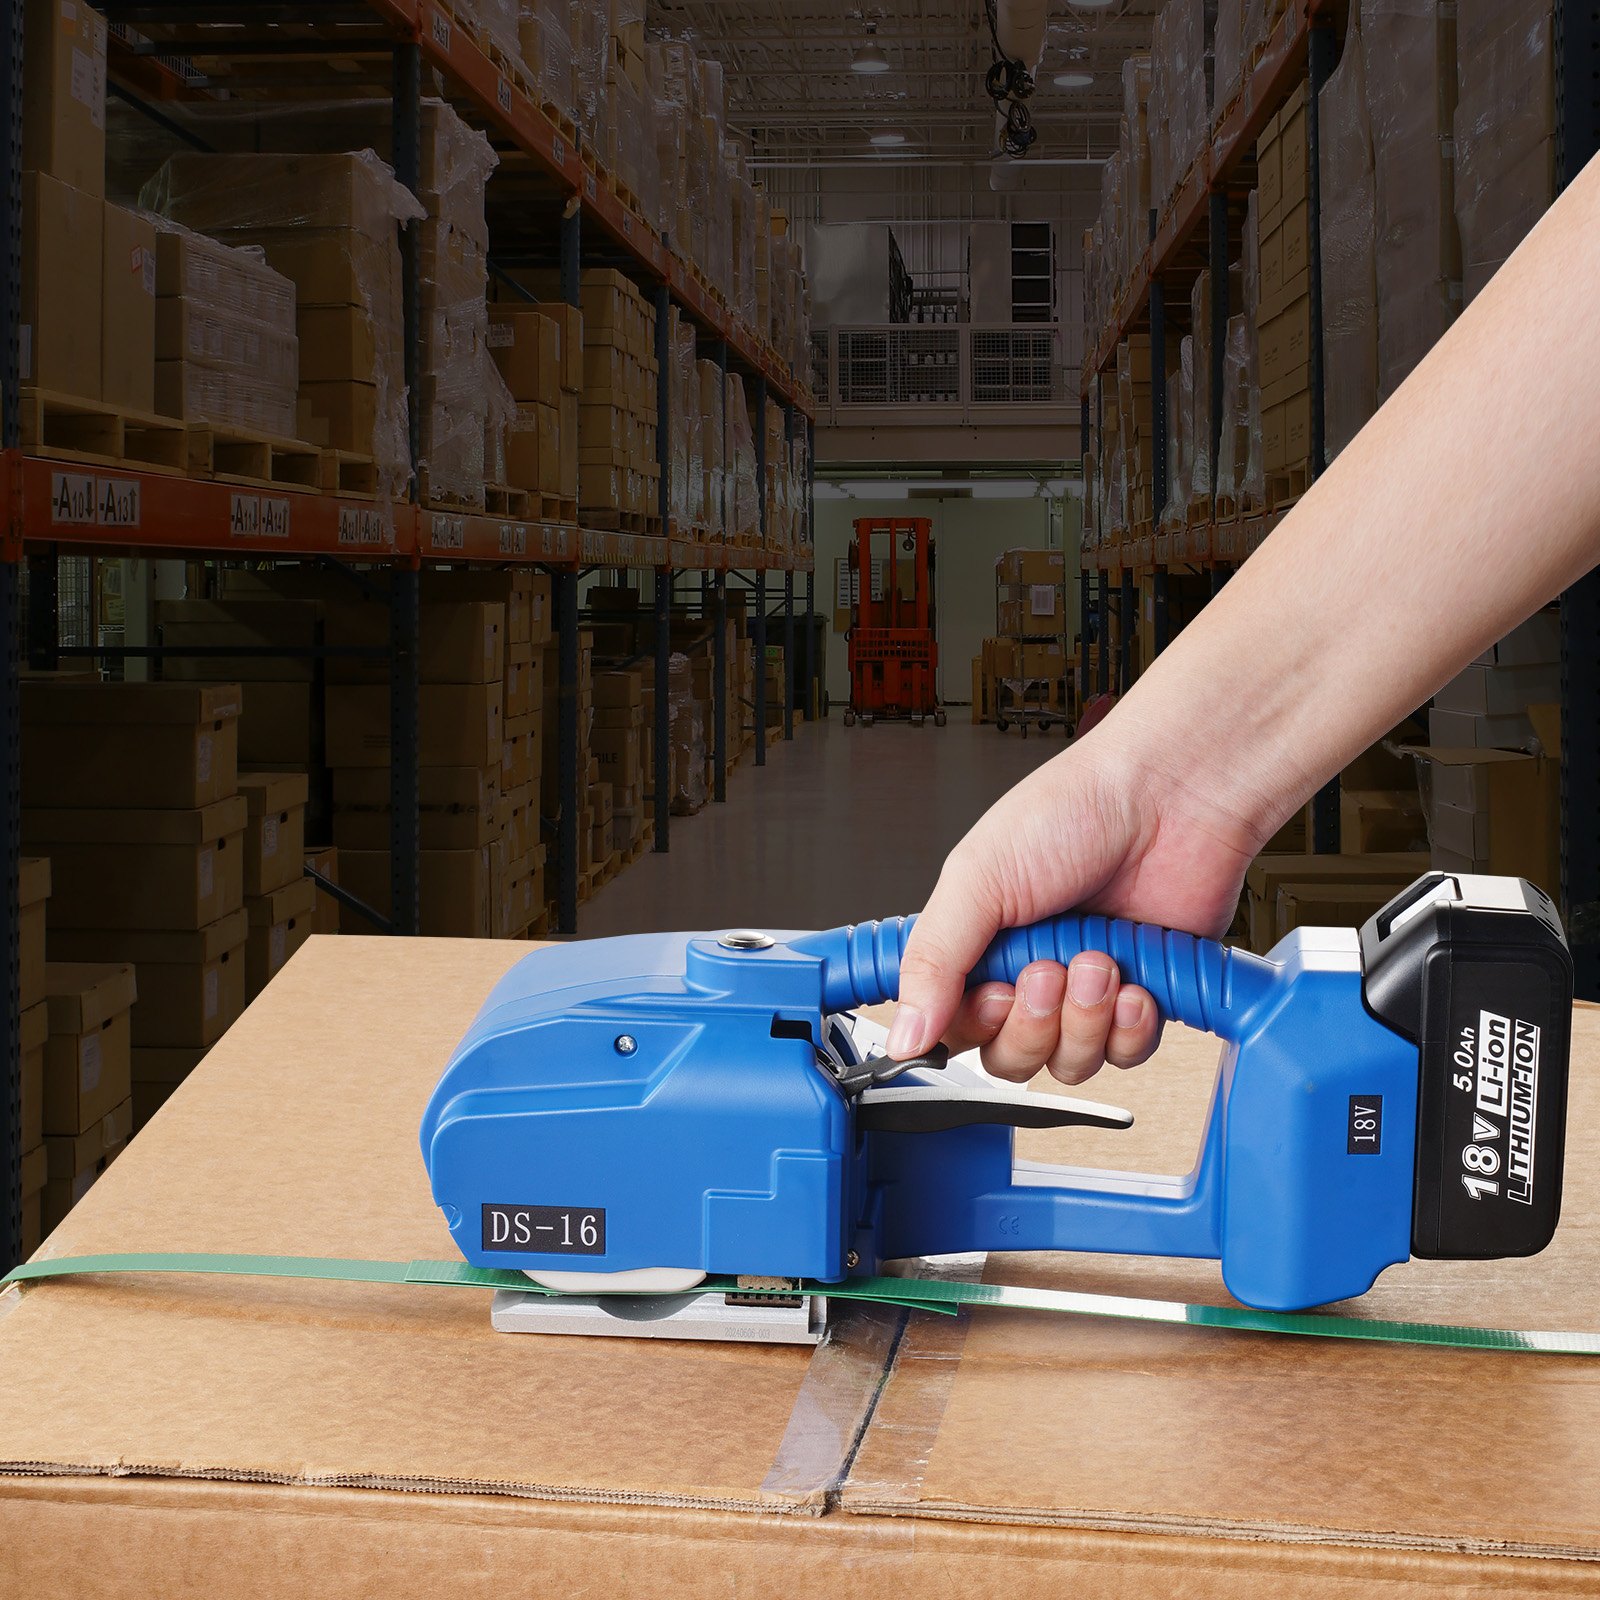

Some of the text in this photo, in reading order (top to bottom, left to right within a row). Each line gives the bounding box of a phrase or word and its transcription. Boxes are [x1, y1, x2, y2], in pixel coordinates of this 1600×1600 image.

[1453, 1026, 1475, 1093] 5.0Ah
[1480, 1018, 1507, 1107] Li-ion
[1353, 1105, 1377, 1143] 18V
[1508, 1019, 1540, 1205] LITHIUM-ION
[491, 1211, 598, 1247] DS-16
